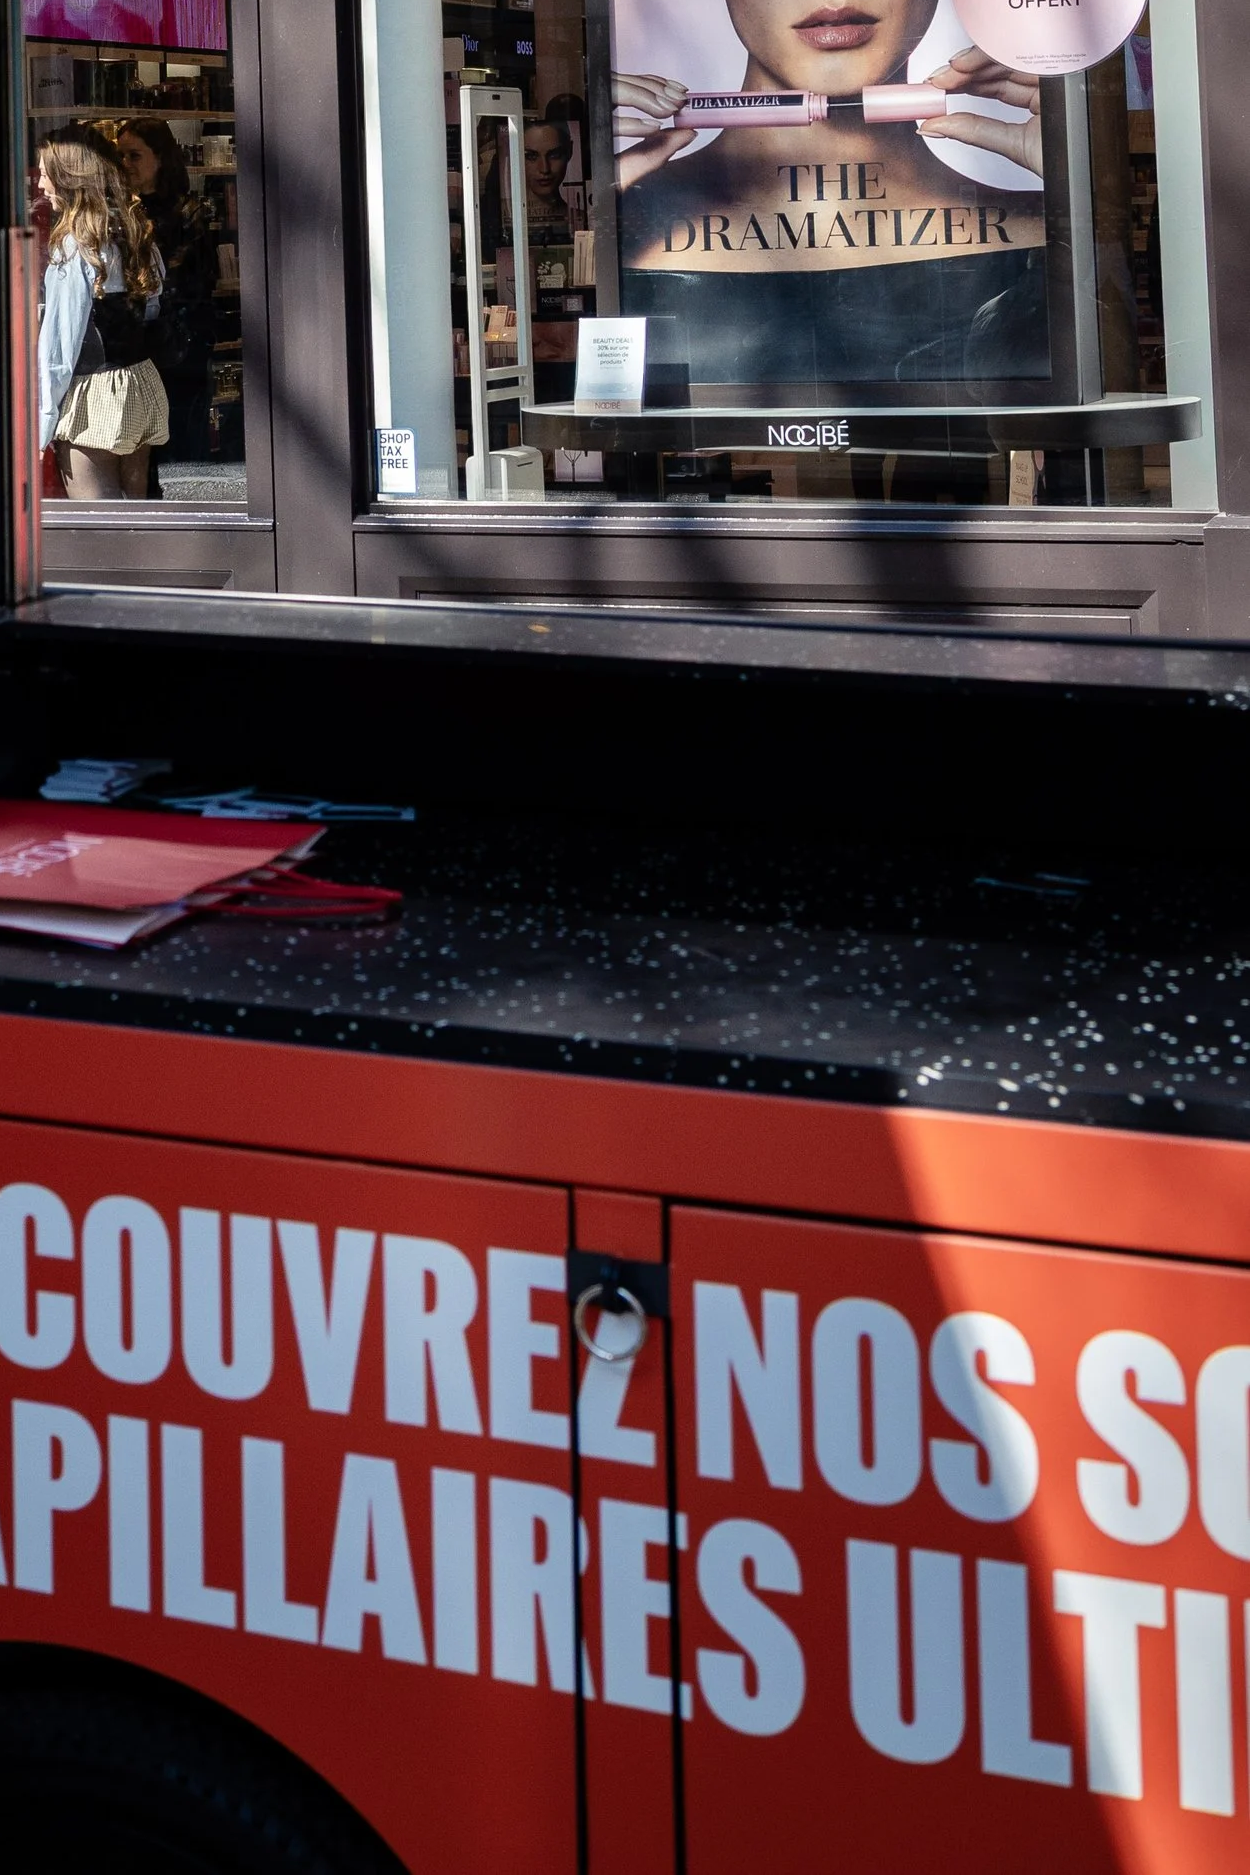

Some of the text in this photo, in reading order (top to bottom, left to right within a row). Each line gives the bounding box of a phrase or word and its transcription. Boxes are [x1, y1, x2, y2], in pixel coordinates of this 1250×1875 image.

[516, 40, 534, 56] BOSS
[693, 96, 781, 109] DRAMATIZER
[777, 162, 887, 202] THE
[662, 206, 1014, 253] DRAMATIZER
[380, 433, 411, 444] SHOP
[768, 420, 850, 446] NOCIBÉ
[380, 445, 402, 457] TAX
[381, 459, 409, 469] FREE
[693, 1280, 1040, 1523] NOS
[846, 1538, 1250, 1817] ULTI
